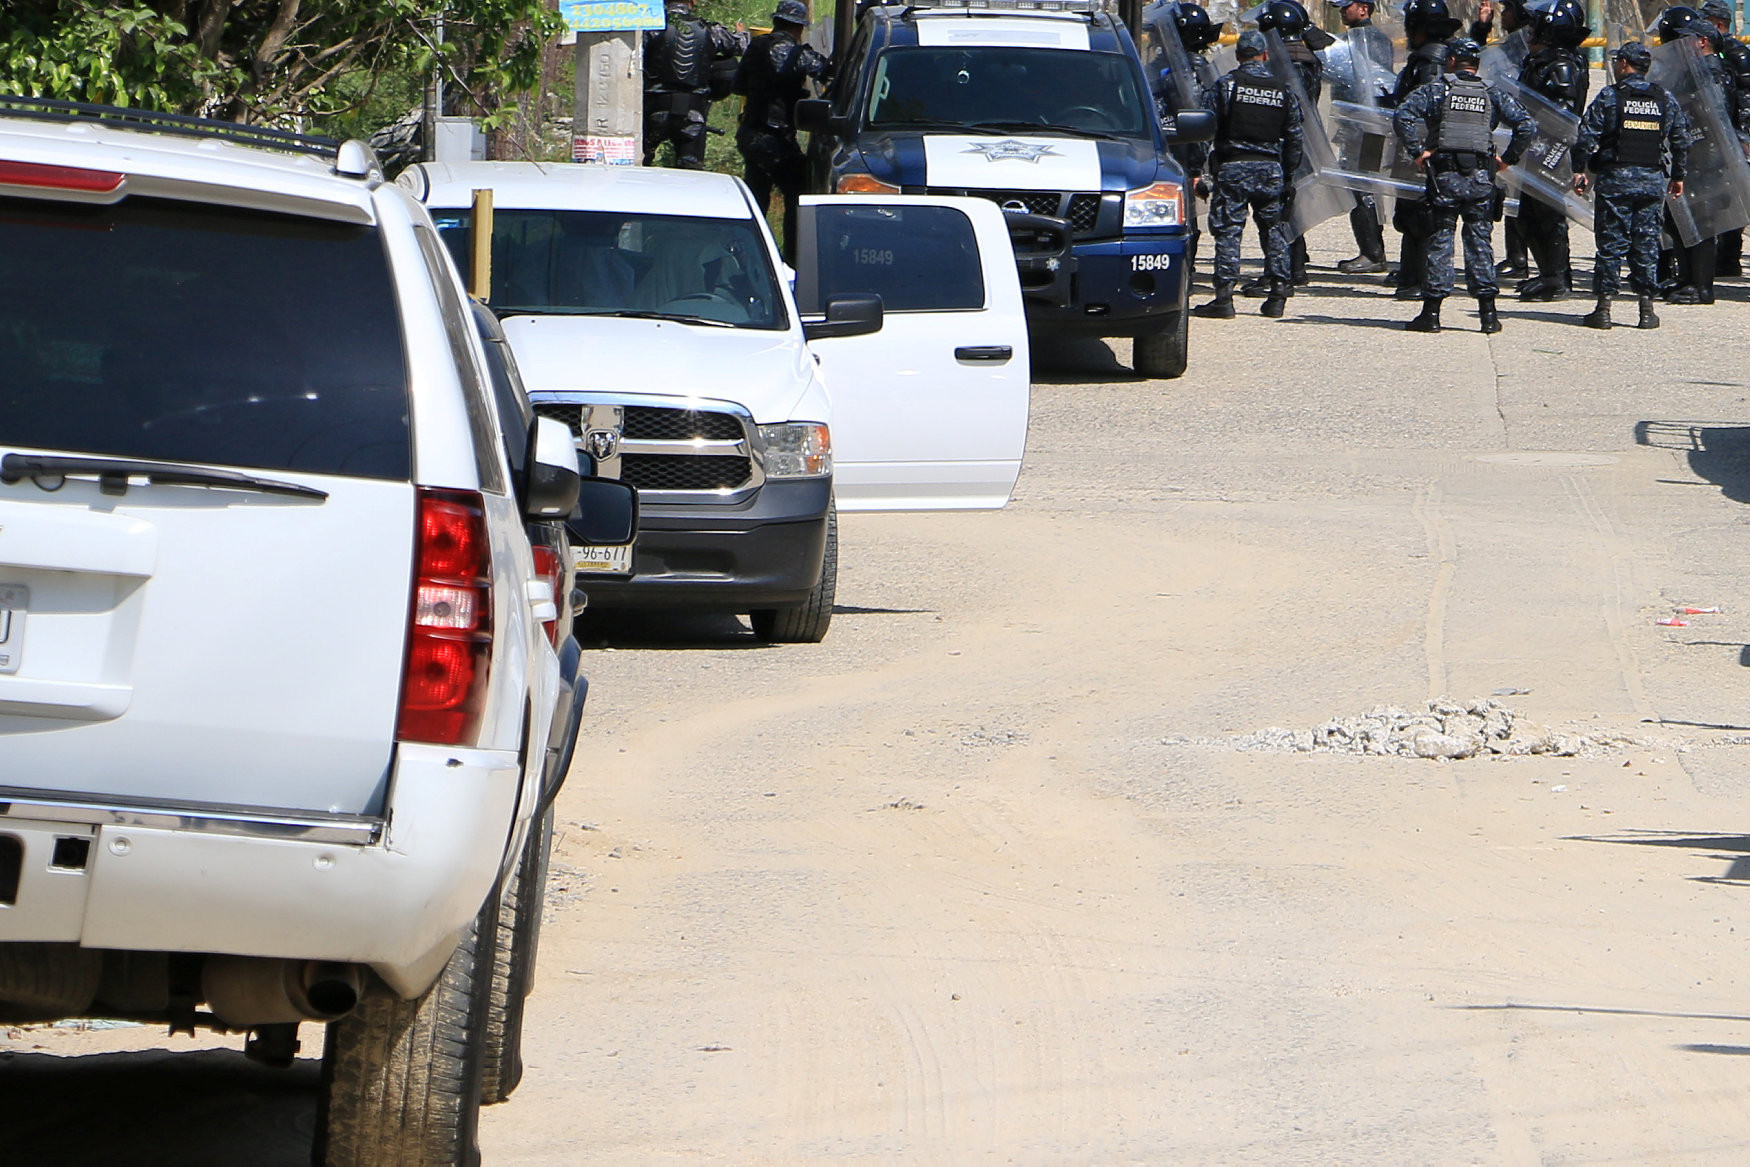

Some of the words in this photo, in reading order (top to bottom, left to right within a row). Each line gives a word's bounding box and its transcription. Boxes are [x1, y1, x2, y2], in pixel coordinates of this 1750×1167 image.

[1236, 94, 1283, 108] FEDERAL
[1450, 102, 1485, 113] FEDERAL
[1623, 106, 1661, 116] FEDERAL
[853, 248, 894, 265] 15849
[1130, 253, 1171, 271] 15849
